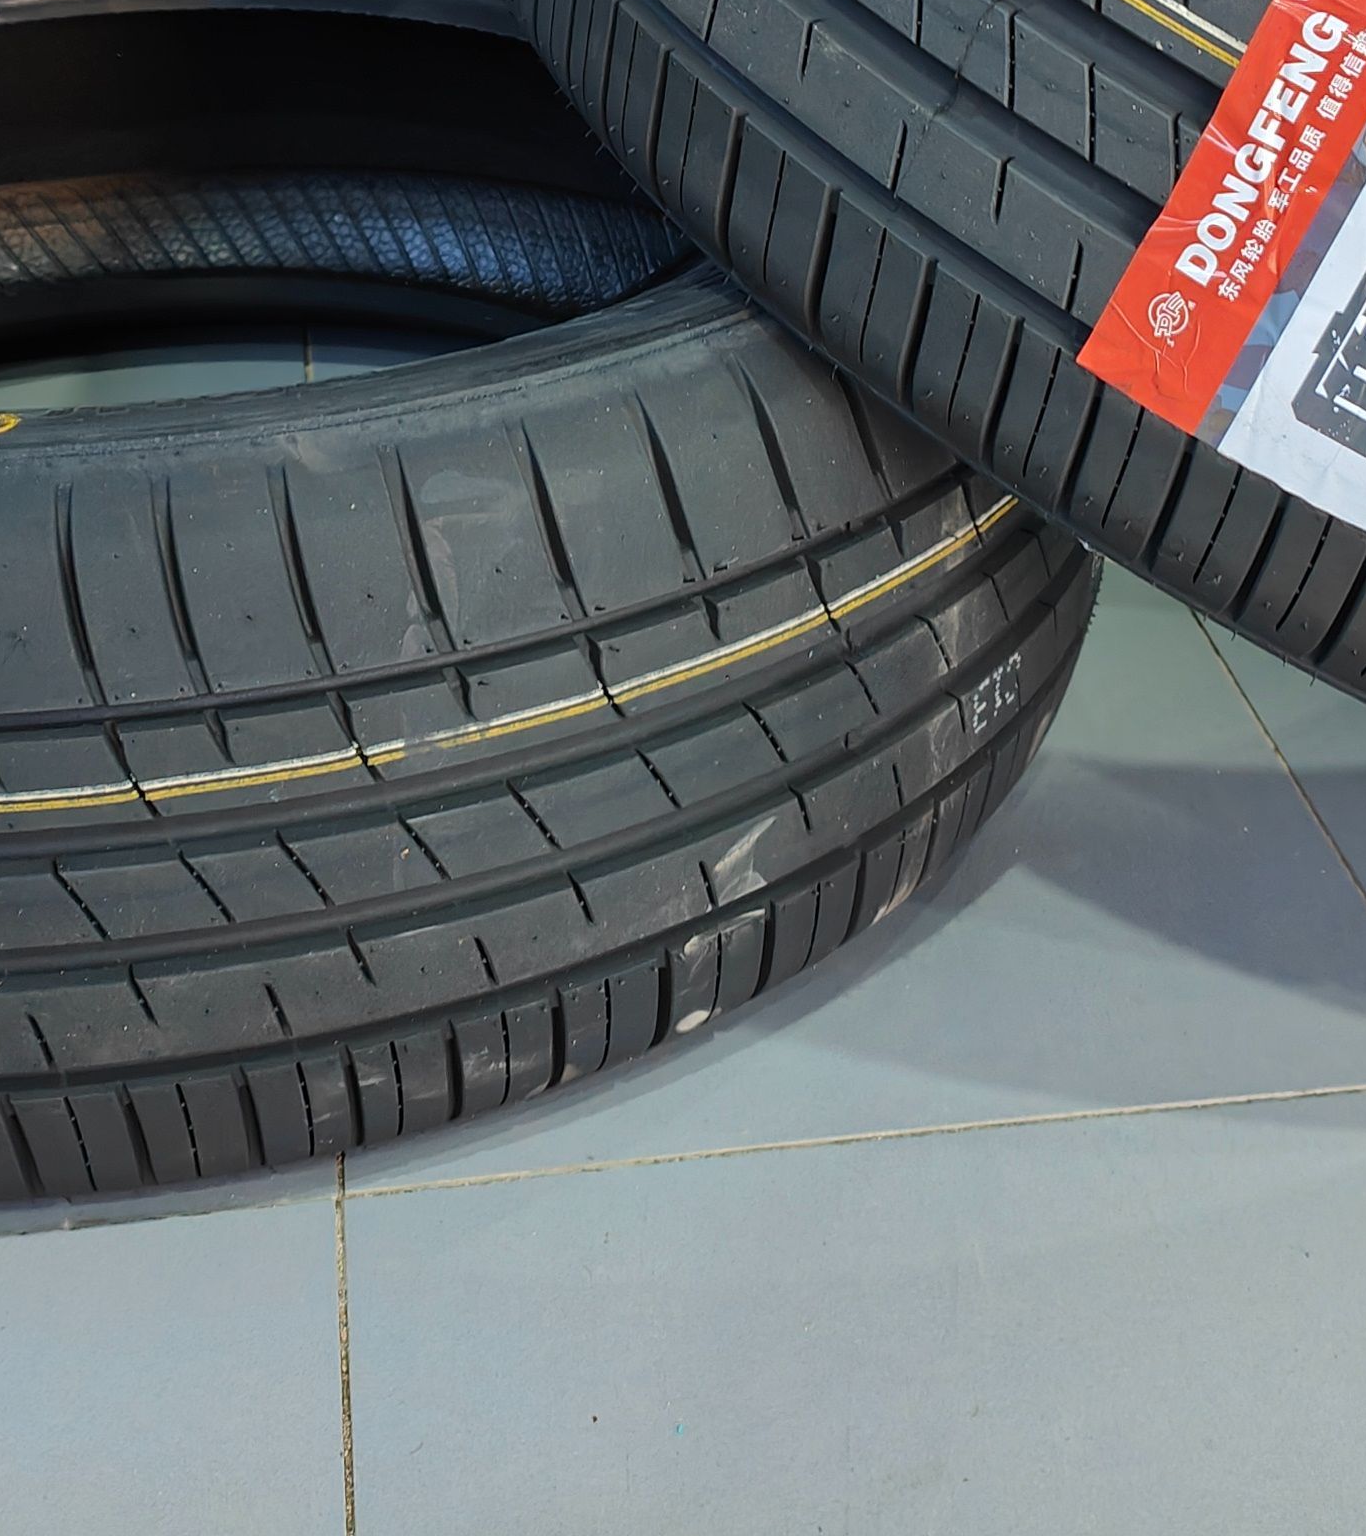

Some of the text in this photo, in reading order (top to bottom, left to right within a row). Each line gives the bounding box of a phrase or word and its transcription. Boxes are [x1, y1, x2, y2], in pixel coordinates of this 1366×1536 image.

[1175, 7, 1350, 286] DONGFENG
[1215, 215, 1278, 303] 东风轮胎
[1266, 123, 1328, 214] 军工品质
